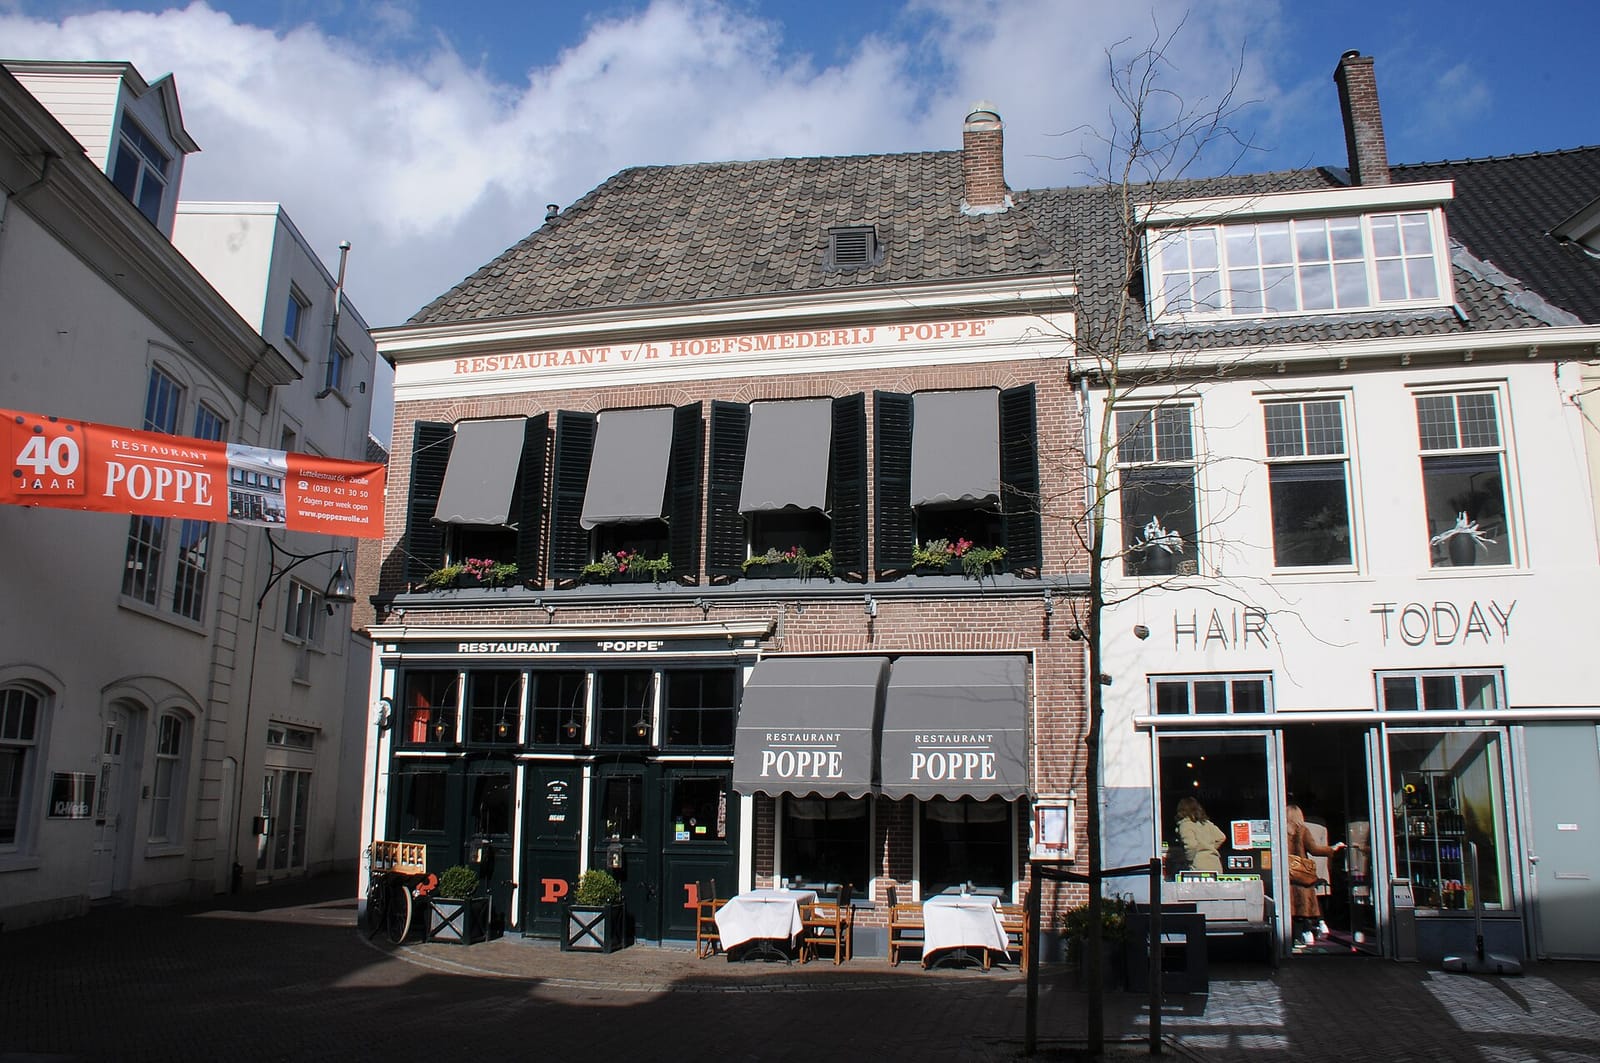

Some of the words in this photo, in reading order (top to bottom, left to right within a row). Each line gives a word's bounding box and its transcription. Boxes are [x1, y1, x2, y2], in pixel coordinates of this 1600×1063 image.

[453, 347, 611, 375] RESTAURANT
[620, 342, 660, 362] v/h
[669, 327, 877, 357] HOEFSMEDERIJ
[16, 436, 80, 476] 40
[111, 439, 208, 461] RESTAURANT
[19, 478, 75, 489] JAAR
[103, 461, 213, 506] POPPE
[312, 484, 331, 494] (038)
[333, 487, 345, 495] 421
[348, 489, 357, 497] 30
[360, 490, 369, 498] 50
[297, 495, 302, 503] 7
[303, 496, 323, 506] dagen
[335, 501, 352, 509] week
[298, 510, 369, 524] www.poppezwolle.nl
[1173, 606, 1269, 652] HAIR
[1370, 600, 1517, 647] TODAY
[458, 642, 560, 653] RESTAURANT
[597, 641, 664, 652] "POPPE"
[766, 733, 841, 742] RESTAURANT
[914, 734, 993, 743] RESTAURANT
[759, 750, 843, 778] POPPE
[910, 752, 997, 780] POPPE
[541, 878, 569, 903] P
